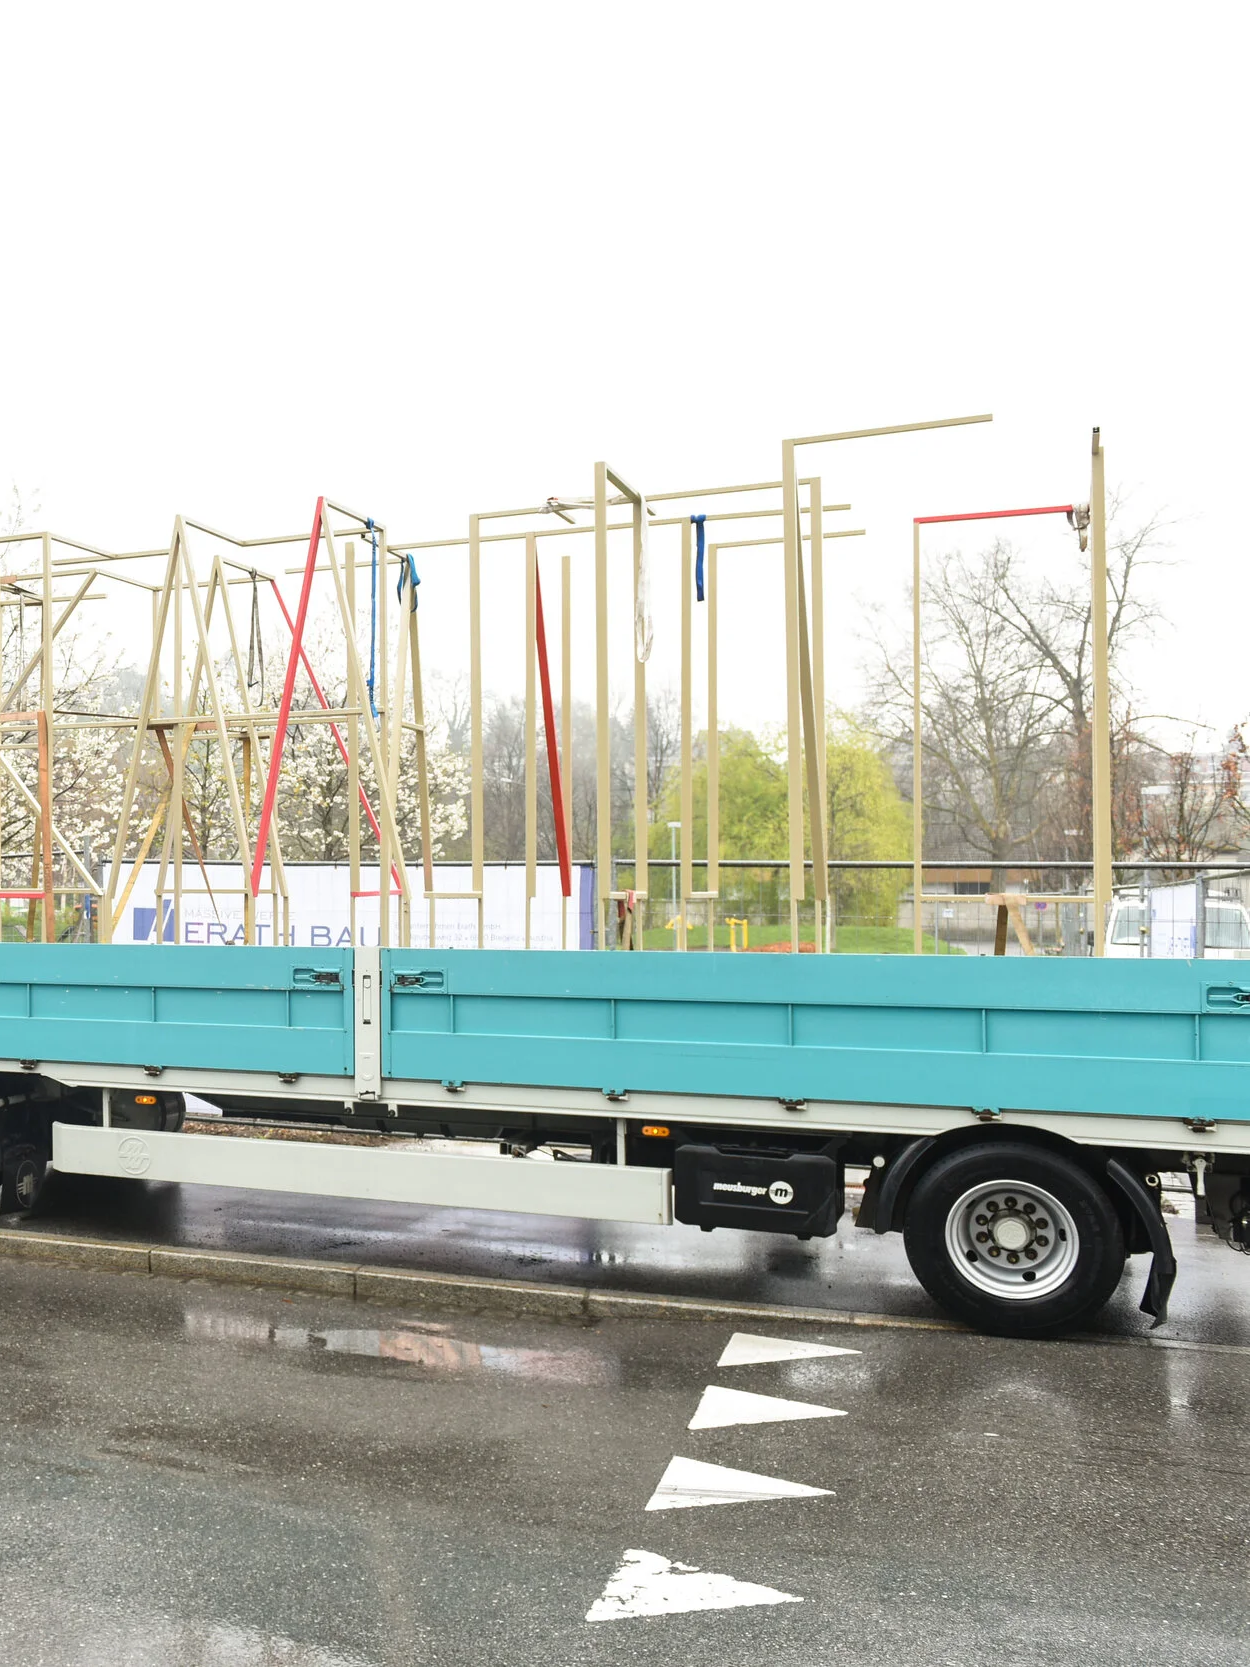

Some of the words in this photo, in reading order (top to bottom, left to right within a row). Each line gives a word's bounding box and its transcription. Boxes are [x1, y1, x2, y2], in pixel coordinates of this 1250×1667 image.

[184, 922, 295, 946] ERATH
[310, 925, 382, 947] BAU
[713, 1182, 767, 1196] meusburger
